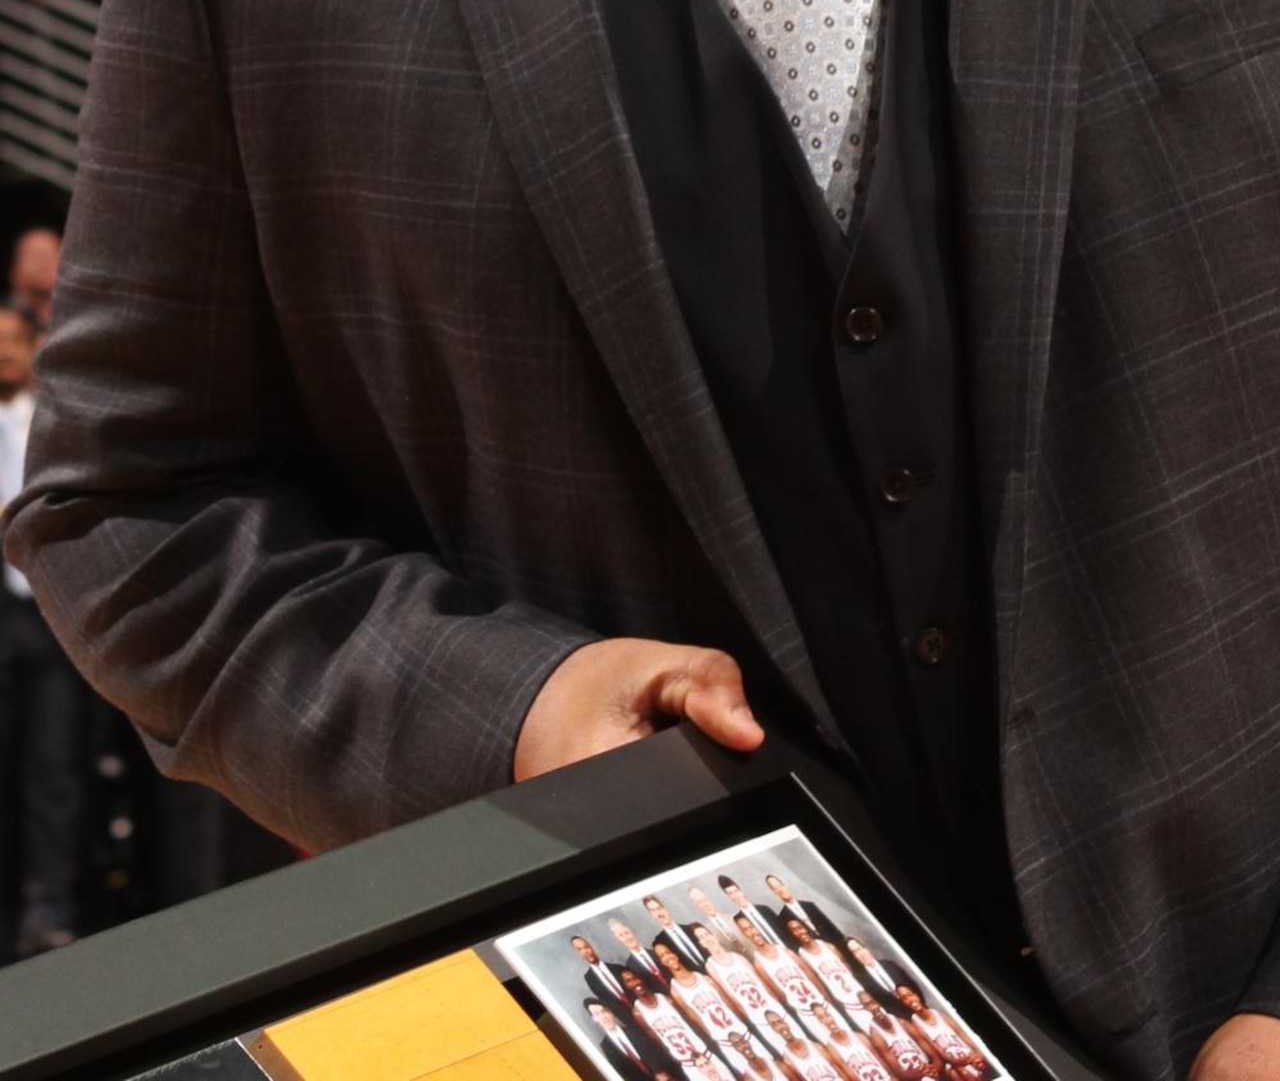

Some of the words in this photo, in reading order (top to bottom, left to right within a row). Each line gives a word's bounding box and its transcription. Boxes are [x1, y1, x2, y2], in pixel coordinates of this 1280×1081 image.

[739, 986, 766, 1009] 32
[789, 981, 816, 1004] 34
[708, 1006, 733, 1029] 42
[667, 1031, 697, 1055] 53
